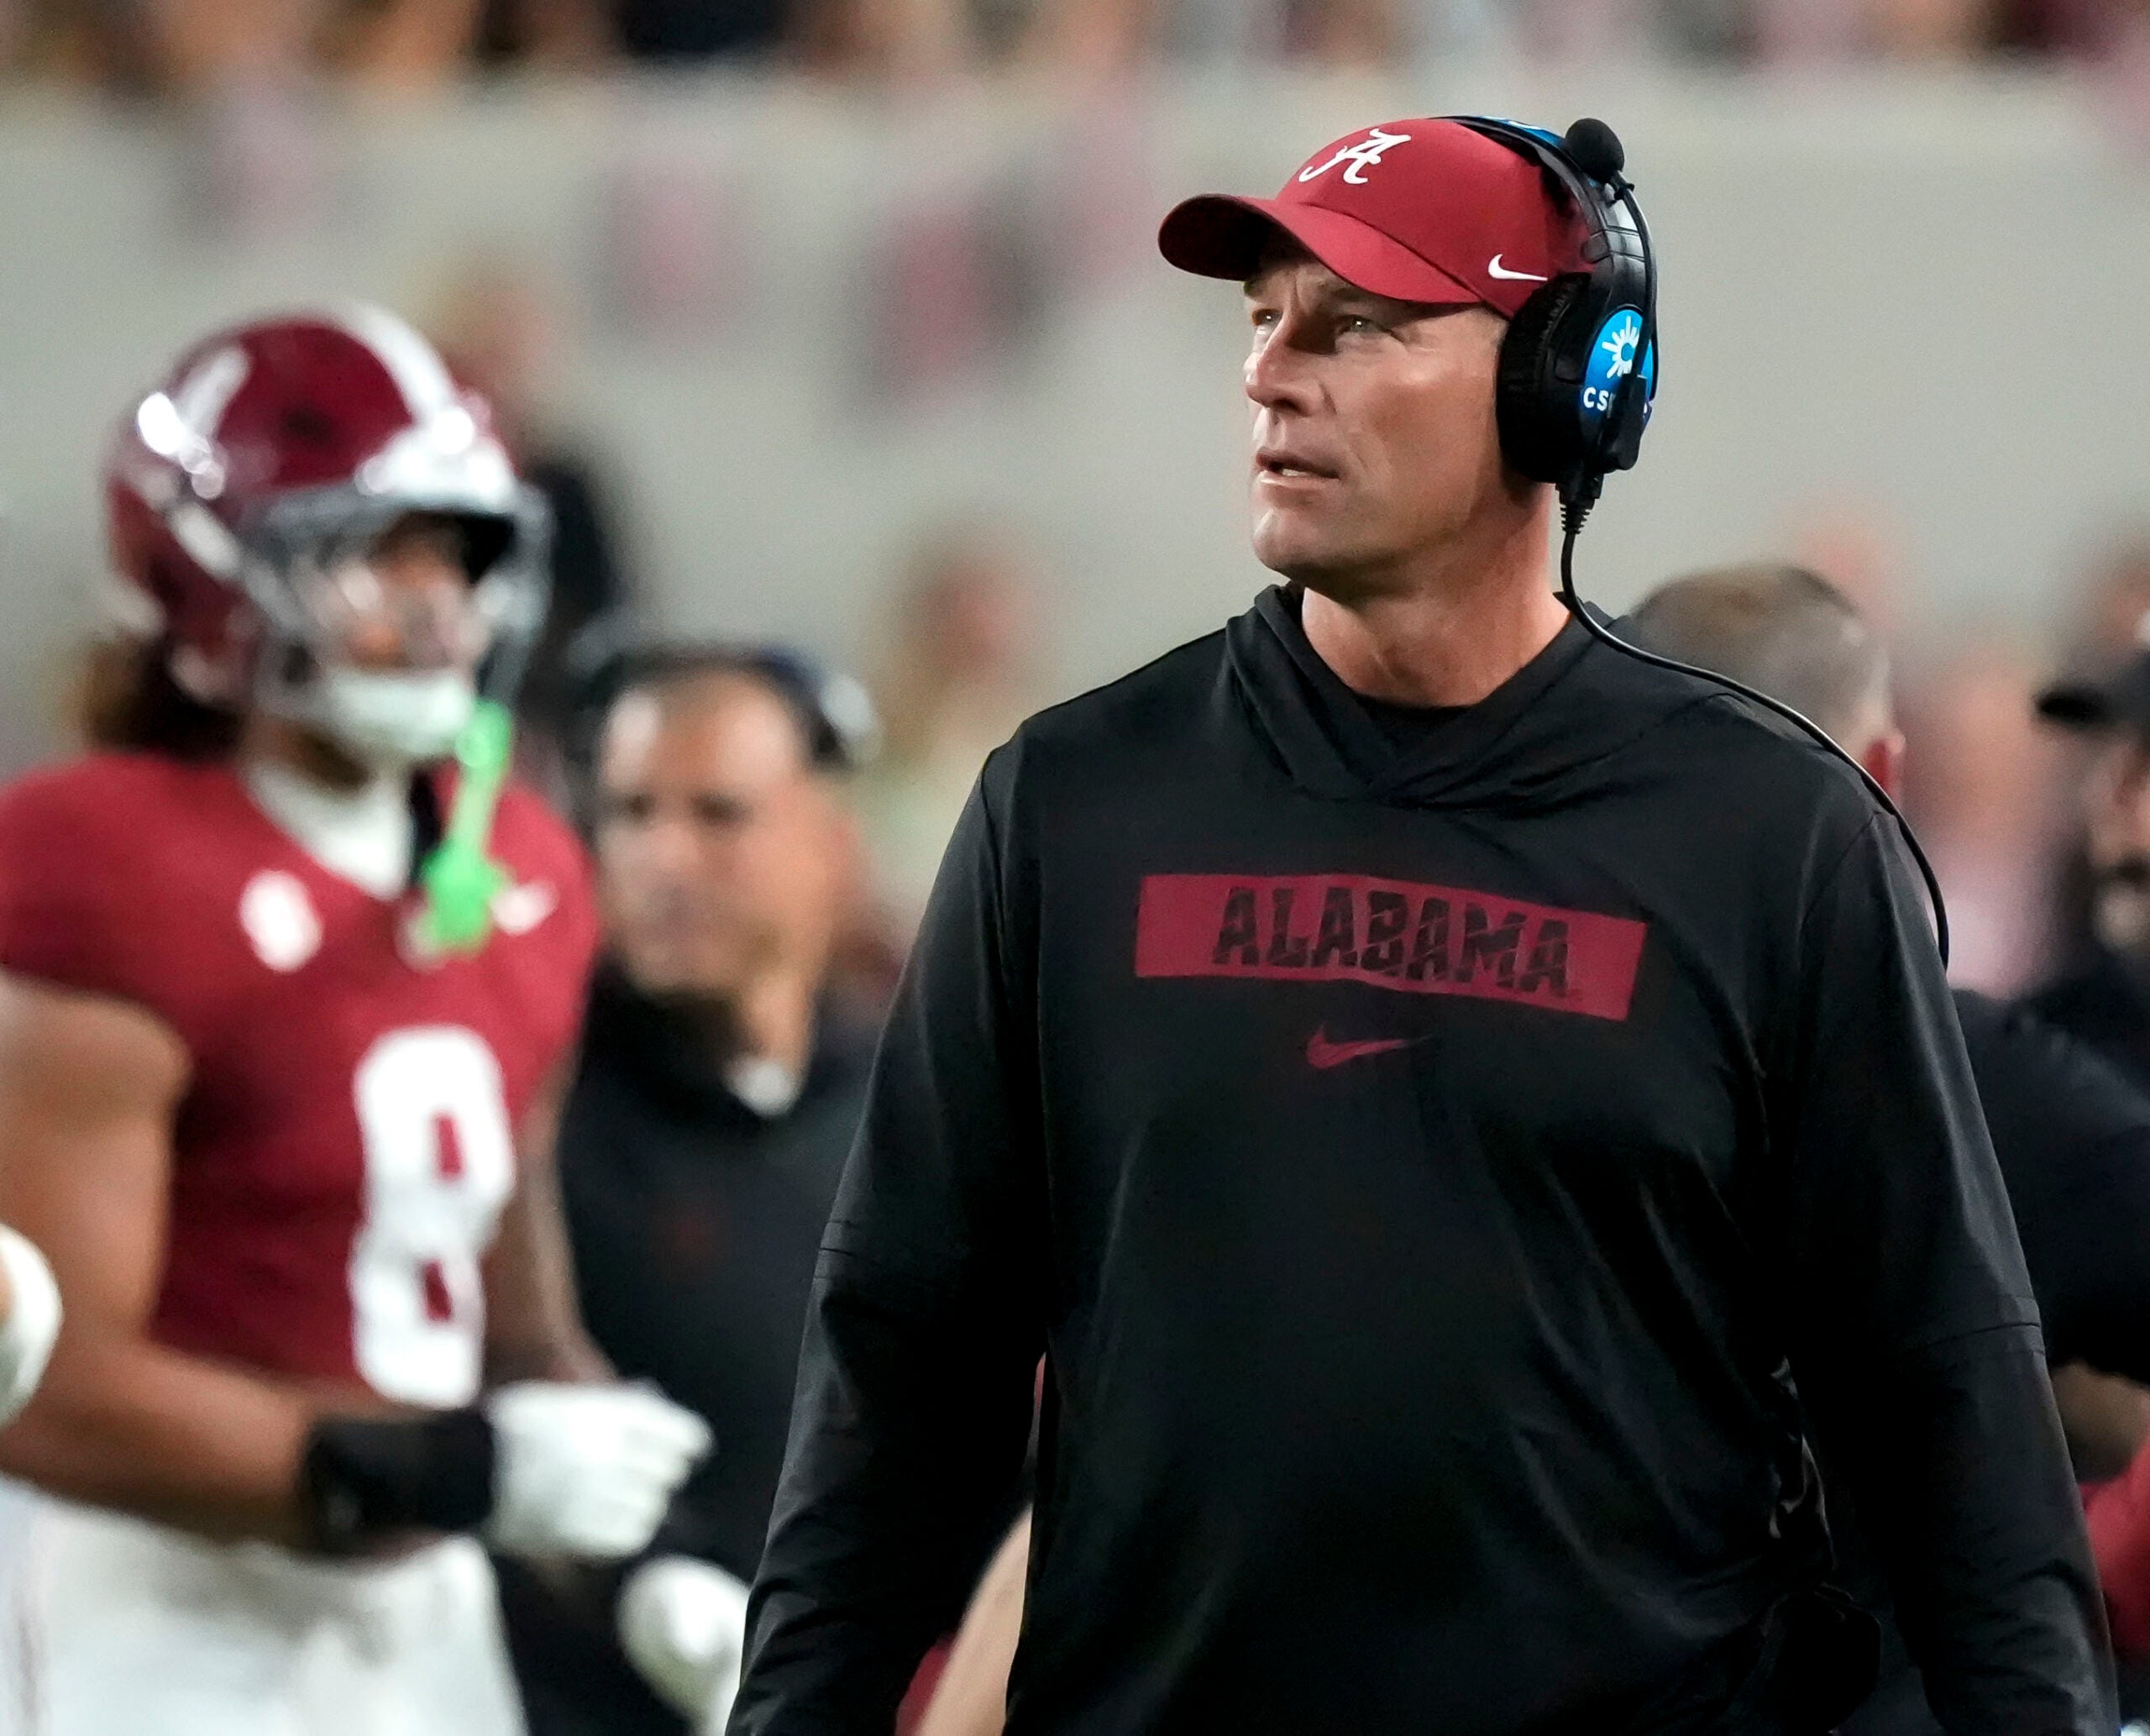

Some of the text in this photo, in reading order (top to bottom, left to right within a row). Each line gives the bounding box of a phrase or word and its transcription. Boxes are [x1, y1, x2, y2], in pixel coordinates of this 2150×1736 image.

[1298, 128, 1412, 185] A
[1583, 387, 1616, 418] CS
[1212, 886, 1570, 998] ALABAMA
[350, 1025, 517, 1409] 8
